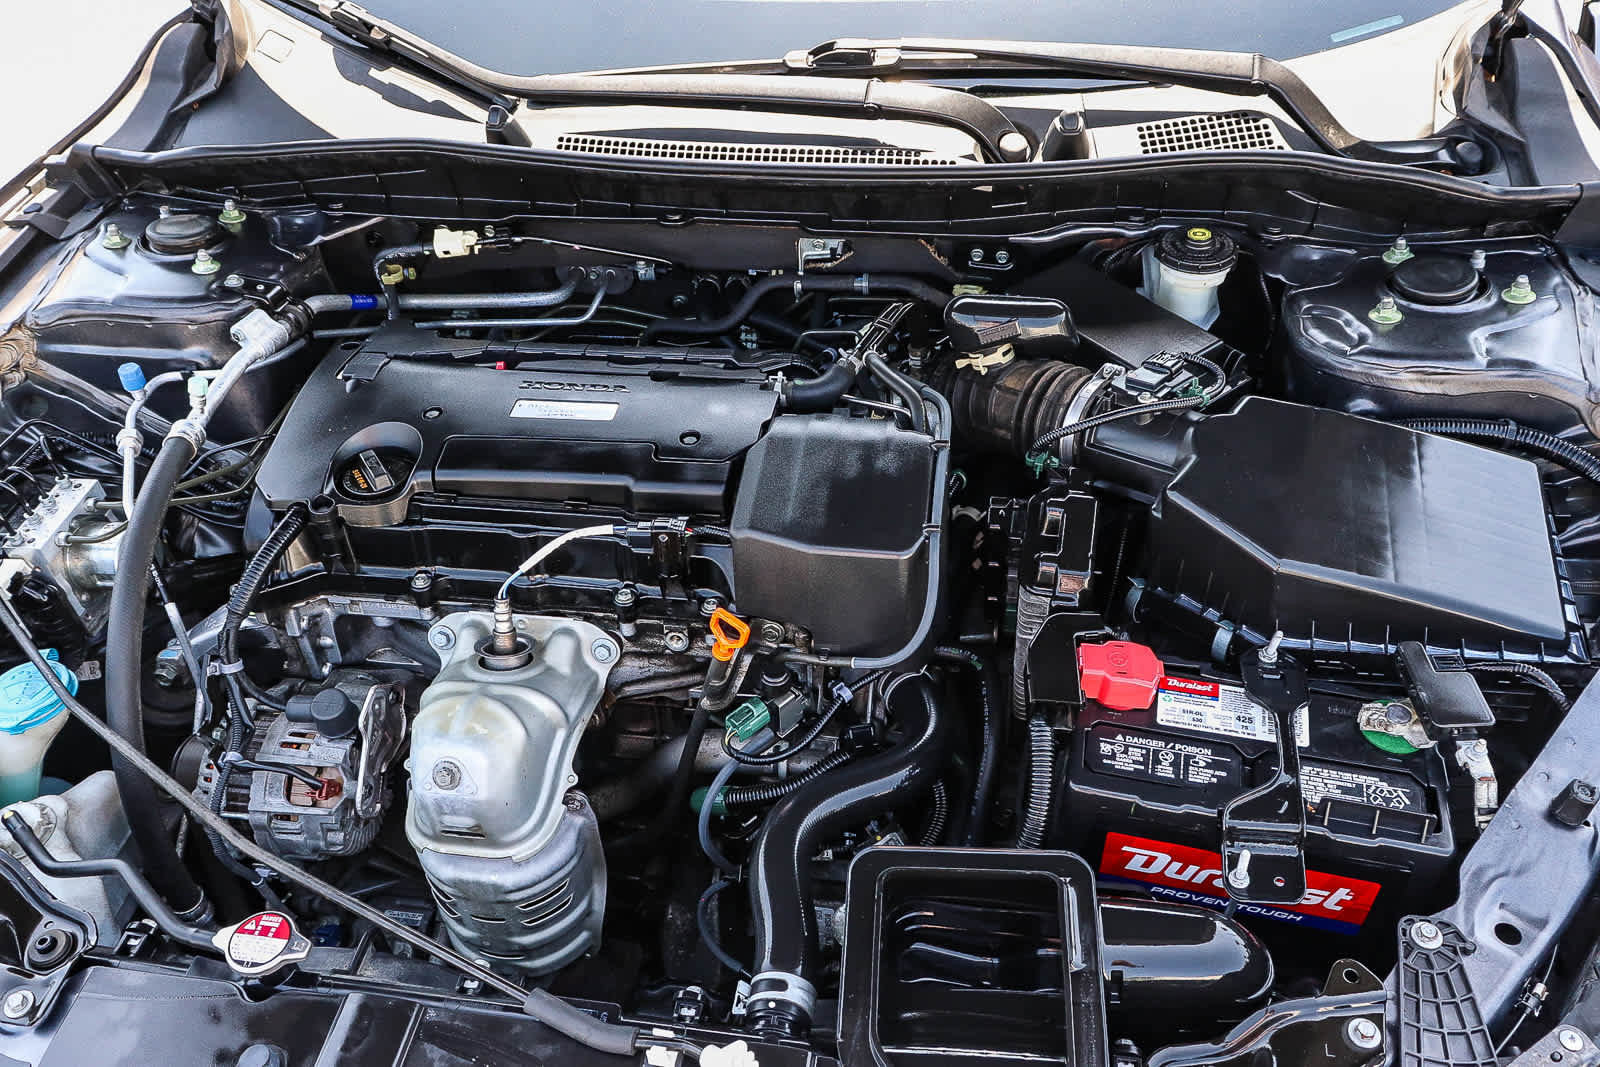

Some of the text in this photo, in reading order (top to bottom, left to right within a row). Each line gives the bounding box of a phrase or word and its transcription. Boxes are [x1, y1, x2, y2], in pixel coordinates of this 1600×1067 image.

[518, 380, 631, 393] HONDA
[1167, 678, 1214, 692] Duralast
[1235, 715, 1254, 724] 425
[1125, 735, 1165, 748] DANGER
[1175, 743, 1212, 756] POISON
[1150, 886, 1303, 922] PROVEN TOUGH
